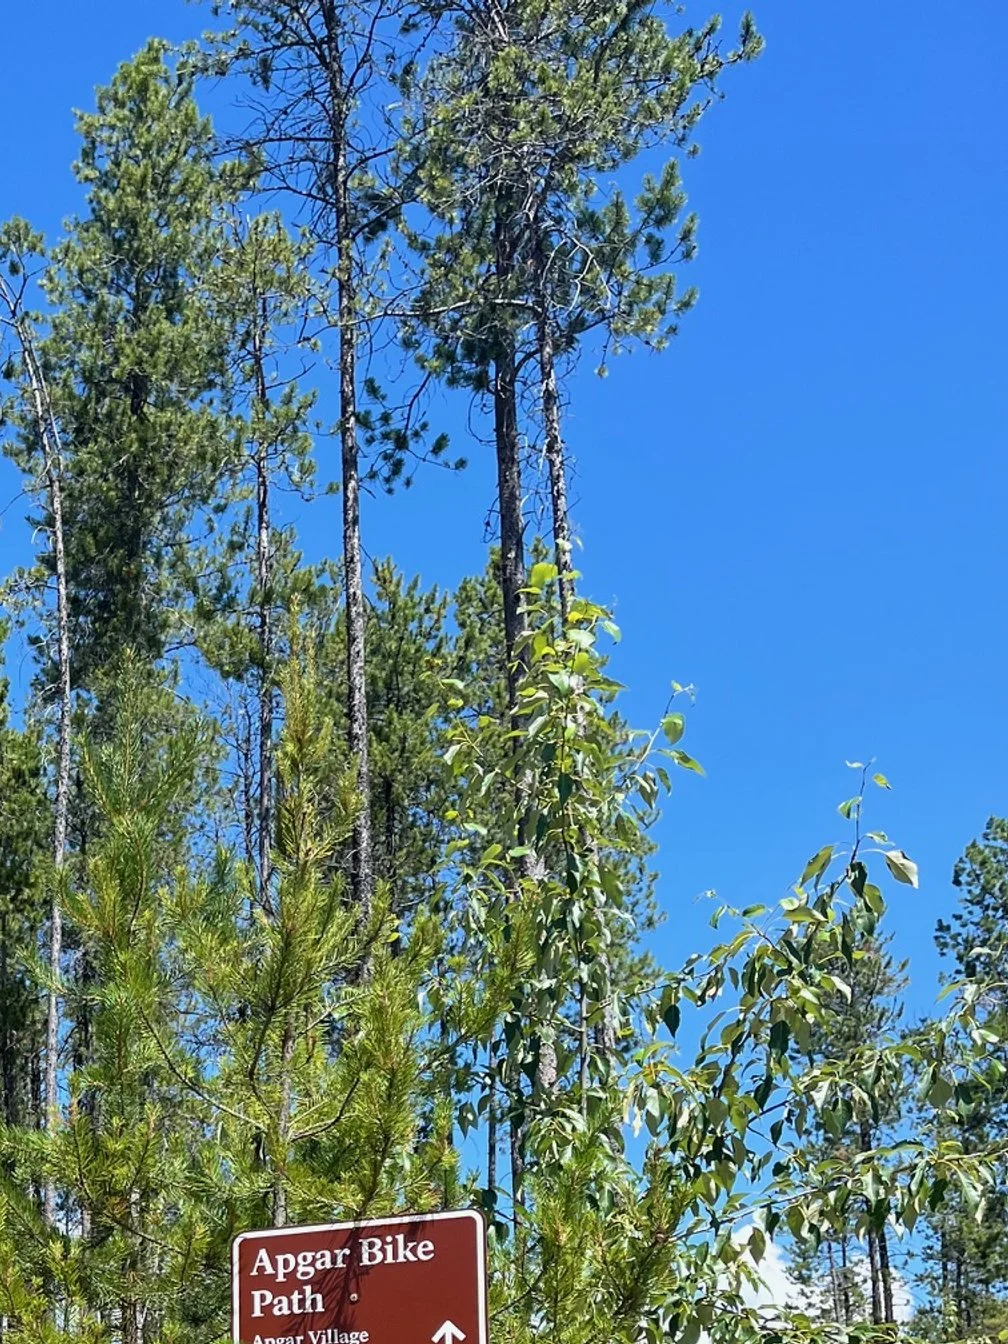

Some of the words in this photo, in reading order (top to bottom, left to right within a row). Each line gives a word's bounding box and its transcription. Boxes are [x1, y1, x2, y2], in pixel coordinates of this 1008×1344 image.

[250, 1246, 351, 1282] Apgar
[358, 1234, 436, 1267] Bike
[251, 1285, 325, 1317] Path
